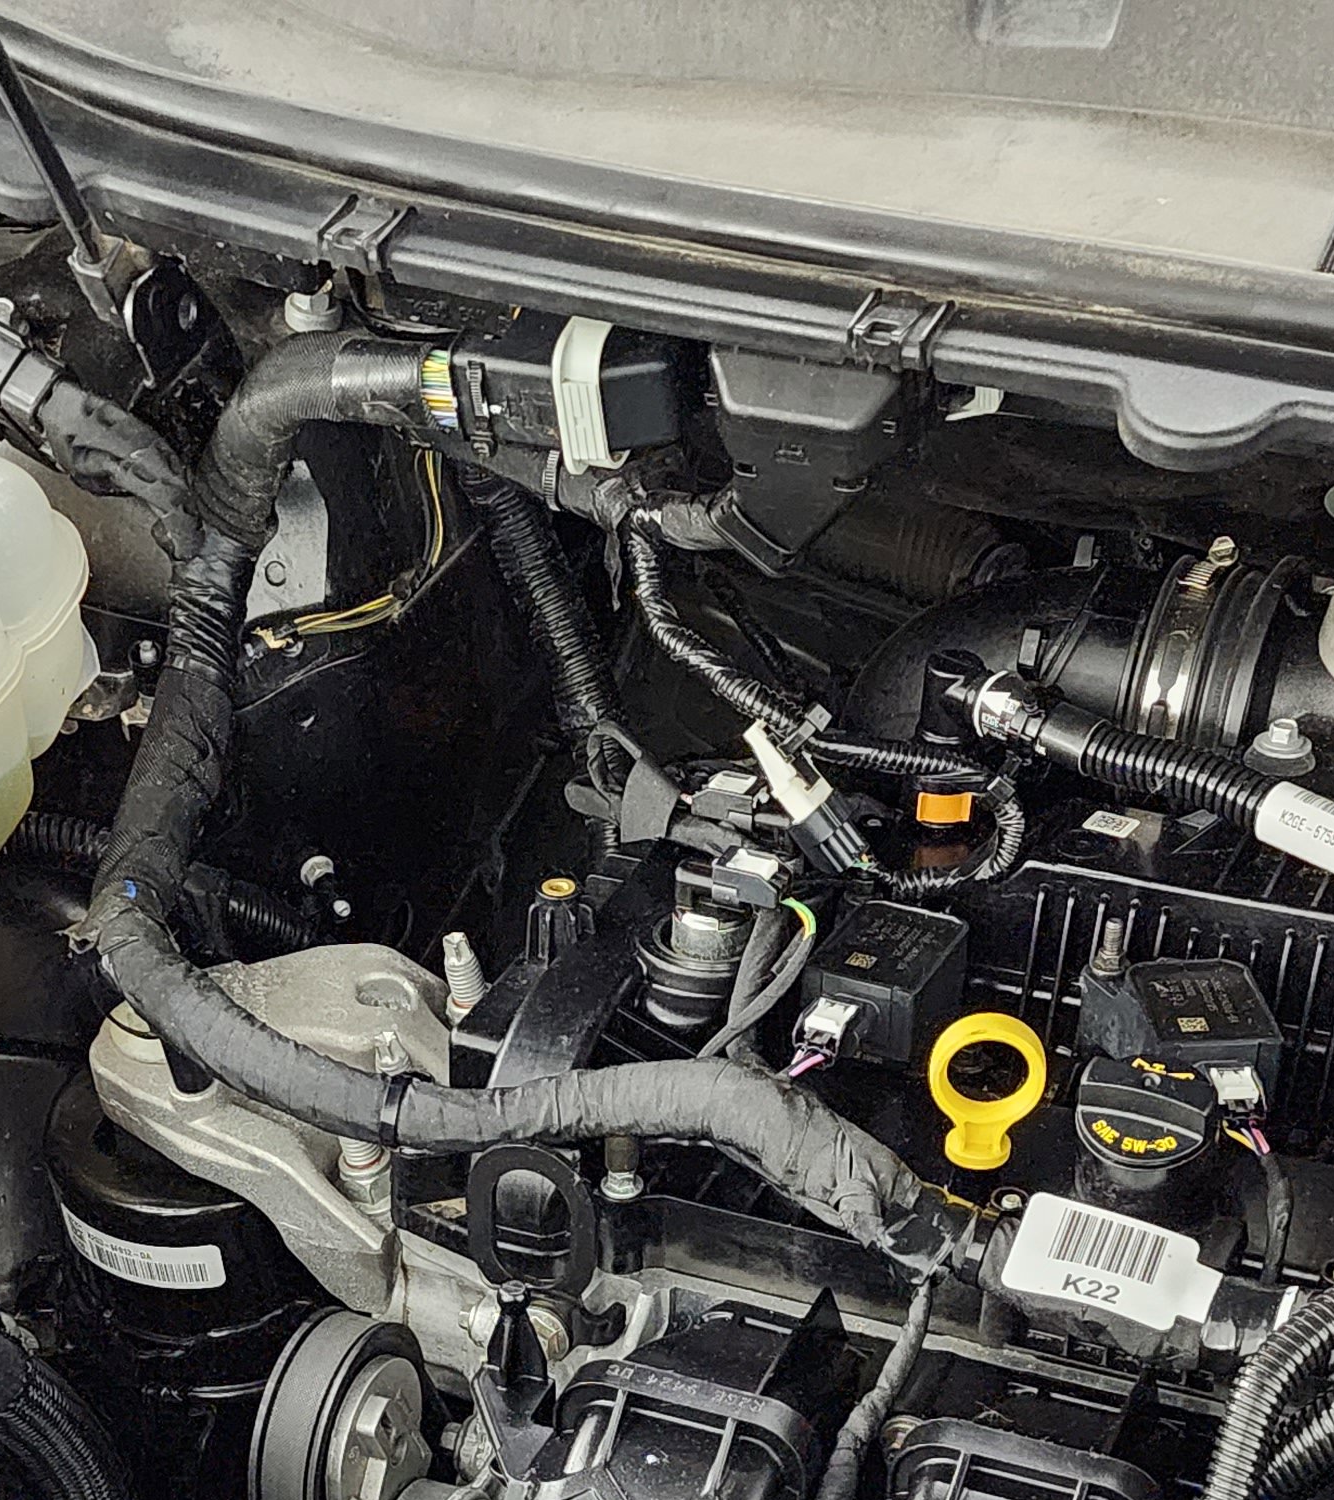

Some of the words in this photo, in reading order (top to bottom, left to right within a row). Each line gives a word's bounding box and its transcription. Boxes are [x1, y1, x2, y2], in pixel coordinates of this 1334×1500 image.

[1087, 1118, 1121, 1145] SAE
[1119, 1134, 1178, 1160] 5W-30
[1060, 1272, 1121, 1305] K22
